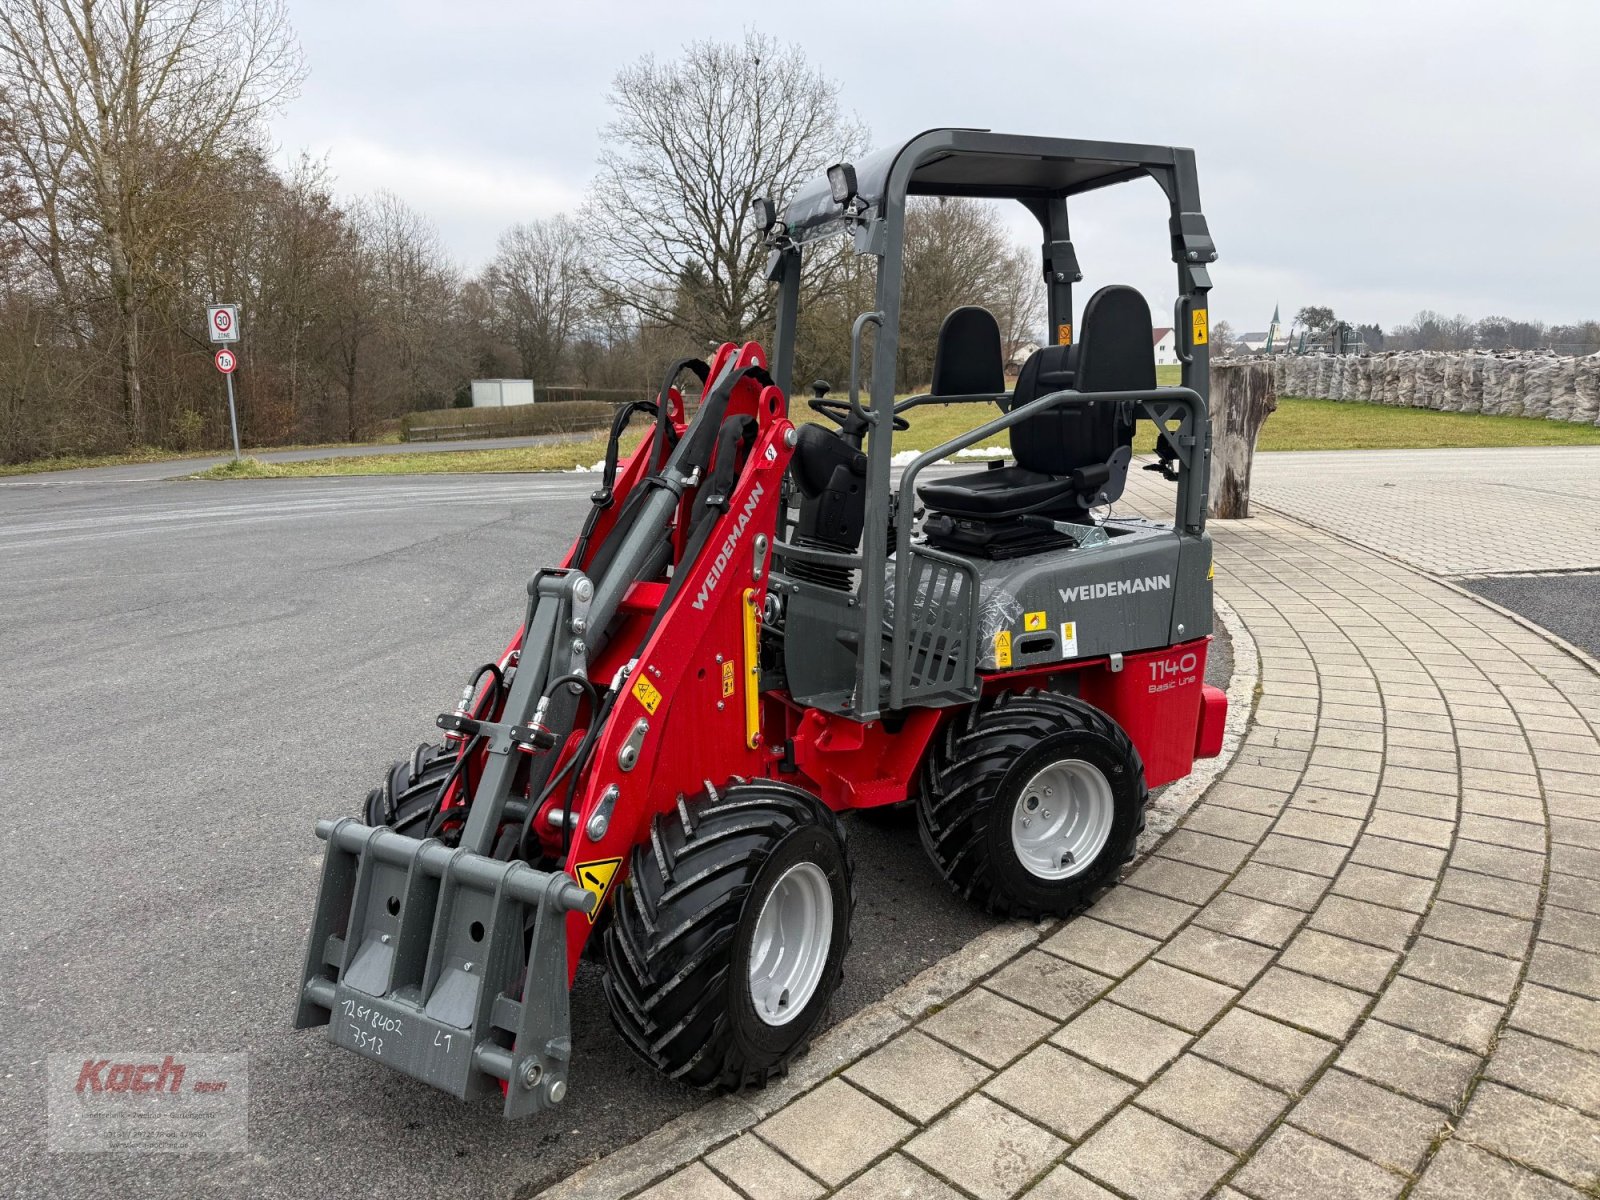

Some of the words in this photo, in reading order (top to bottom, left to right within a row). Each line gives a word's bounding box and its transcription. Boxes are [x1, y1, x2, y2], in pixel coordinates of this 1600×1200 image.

[217, 316, 228, 325] 30
[692, 481, 765, 611] WEIDEMANN
[1058, 574, 1171, 603] WEIDEMANN
[1148, 652, 1197, 681] 1140
[1148, 680, 1176, 693] Basic
[1178, 675, 1196, 686] Line
[350, 1023, 383, 1055] 7513
